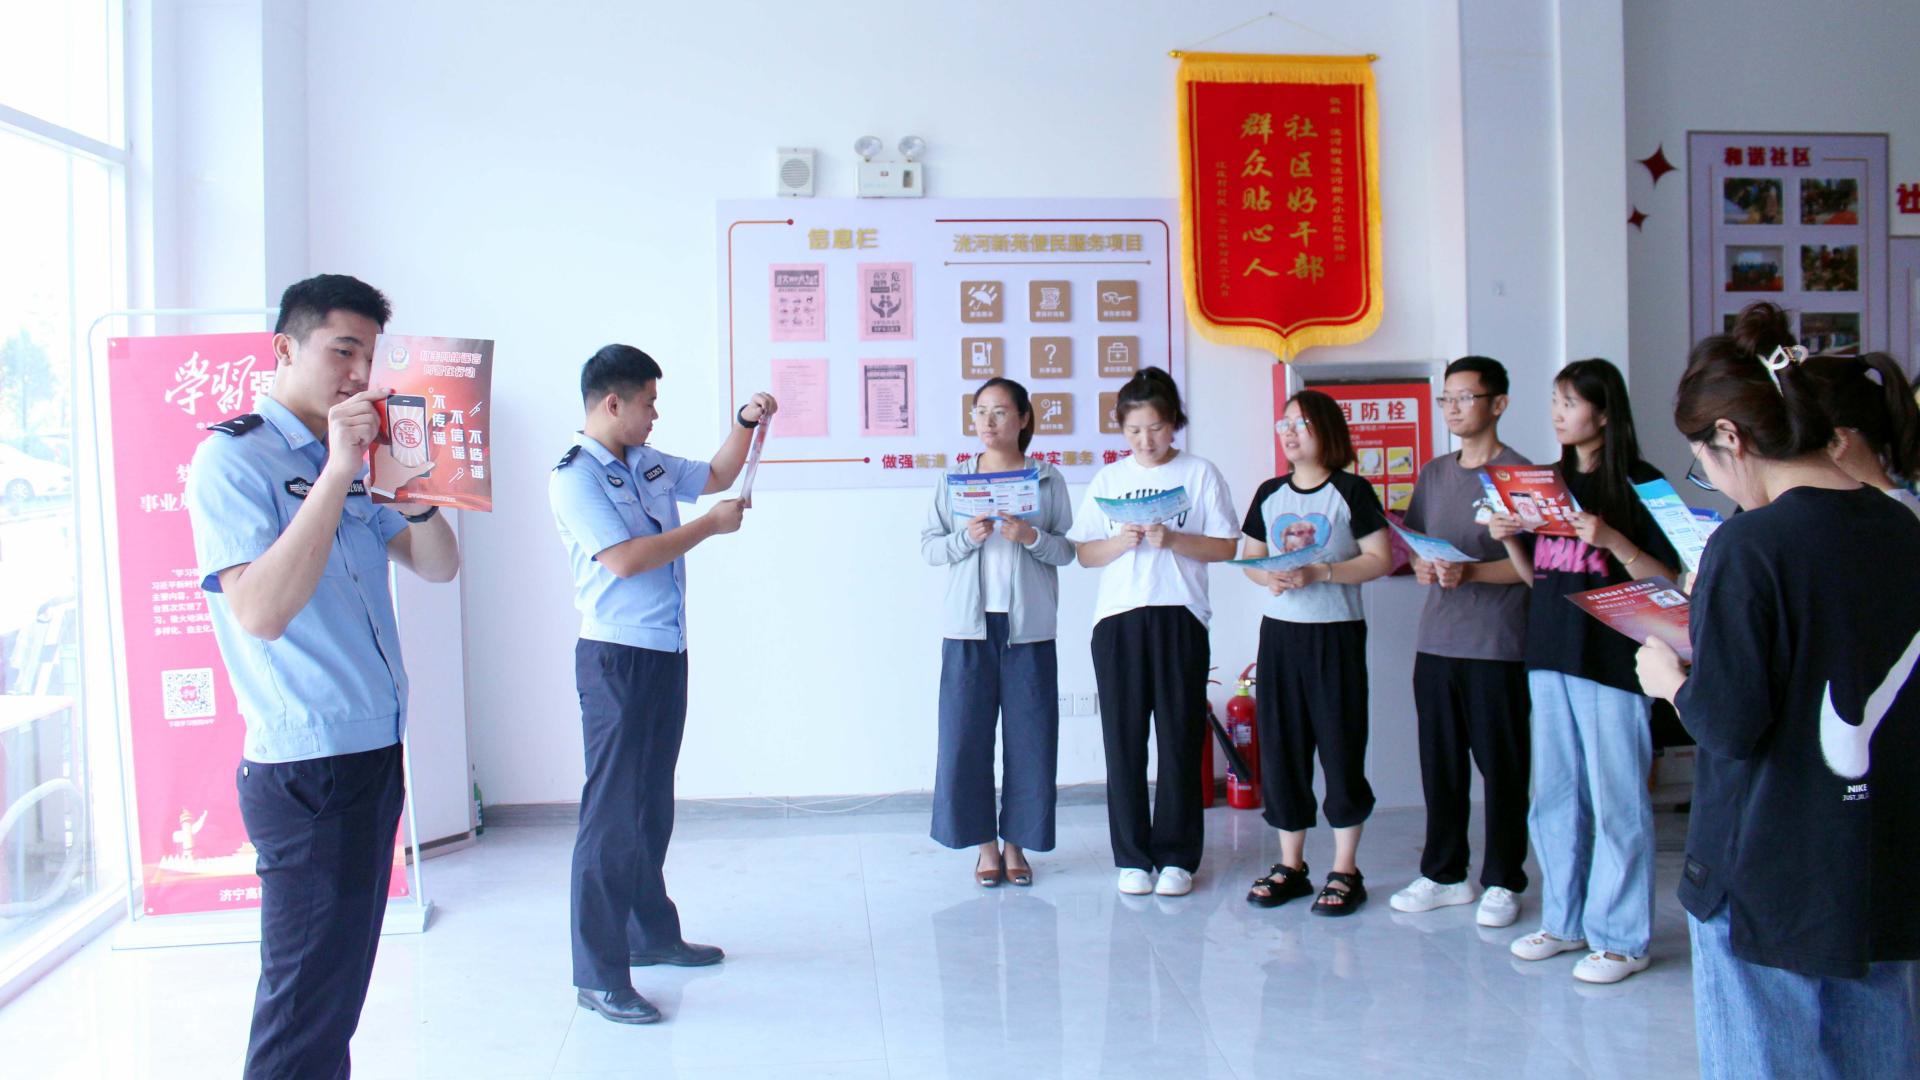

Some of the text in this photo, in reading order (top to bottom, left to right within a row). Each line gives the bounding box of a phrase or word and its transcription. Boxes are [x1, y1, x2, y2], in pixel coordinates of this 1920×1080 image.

[1724, 147, 1811, 167] 和谐社区
[1240, 113, 1279, 277] 群众贴心人
[1284, 114, 1325, 285] 社区好干部
[808, 229, 878, 249] 信息栏
[432, 395, 446, 445] 不传谣
[450, 410, 465, 459] 不信谣
[468, 430, 484, 479] 不造谣
[882, 455, 947, 469] 做强街道
[1847, 783, 1868, 793] NIKE
